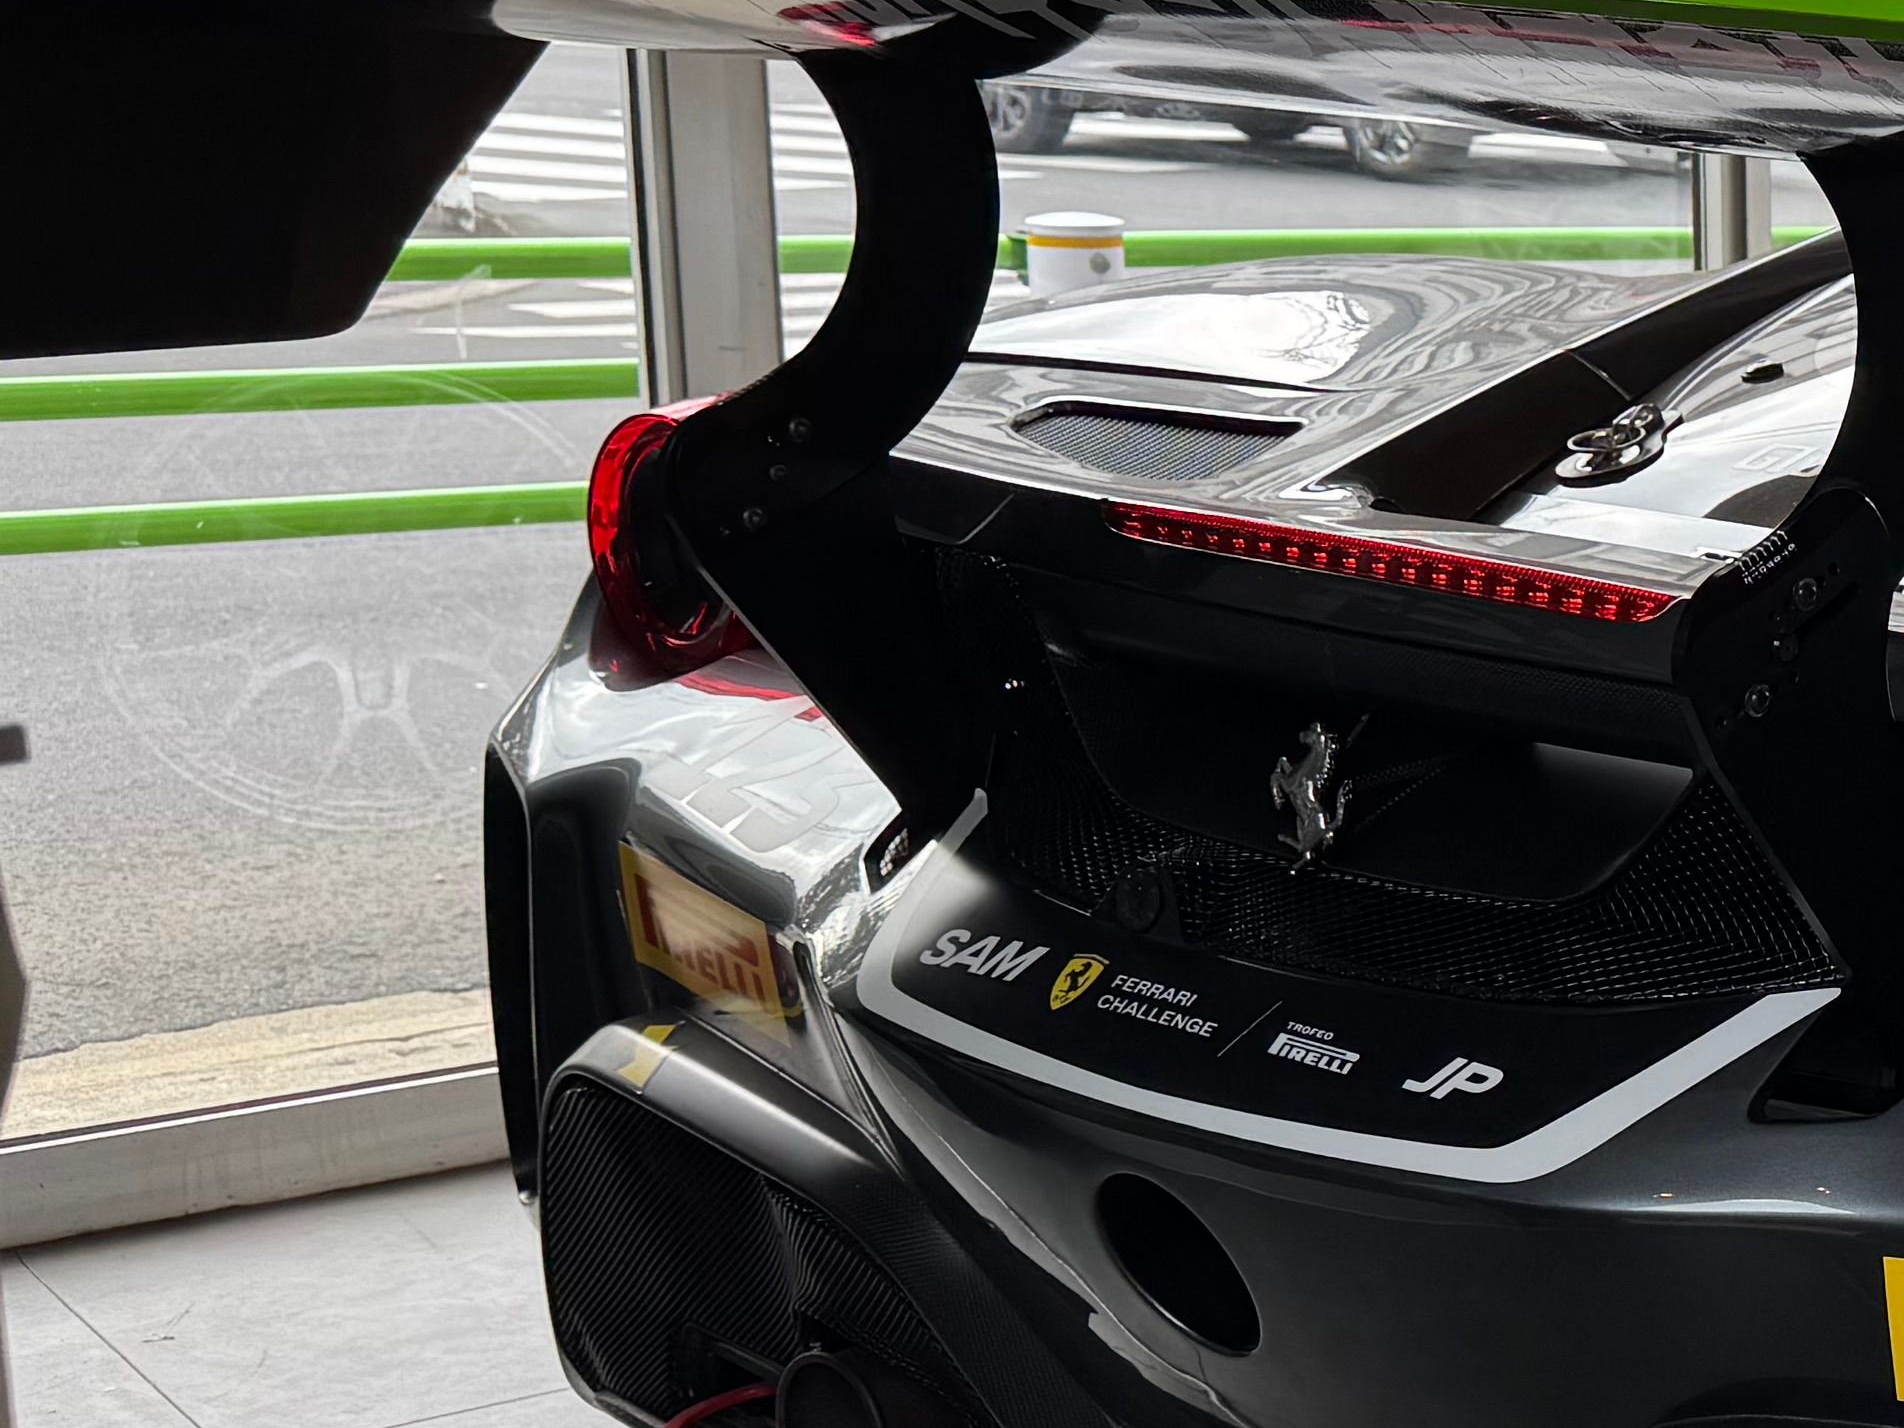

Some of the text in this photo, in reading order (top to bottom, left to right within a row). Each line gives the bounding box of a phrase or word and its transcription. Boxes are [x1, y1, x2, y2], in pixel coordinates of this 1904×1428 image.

[919, 928, 1050, 982] SAM
[1110, 974, 1198, 1007] FERRARI
[1096, 993, 1219, 1038] CHALLENGE
[1287, 1020, 1334, 1040] TROFEO
[1267, 1032, 1360, 1075] PIRELLI
[1401, 1057, 1504, 1100] JP
